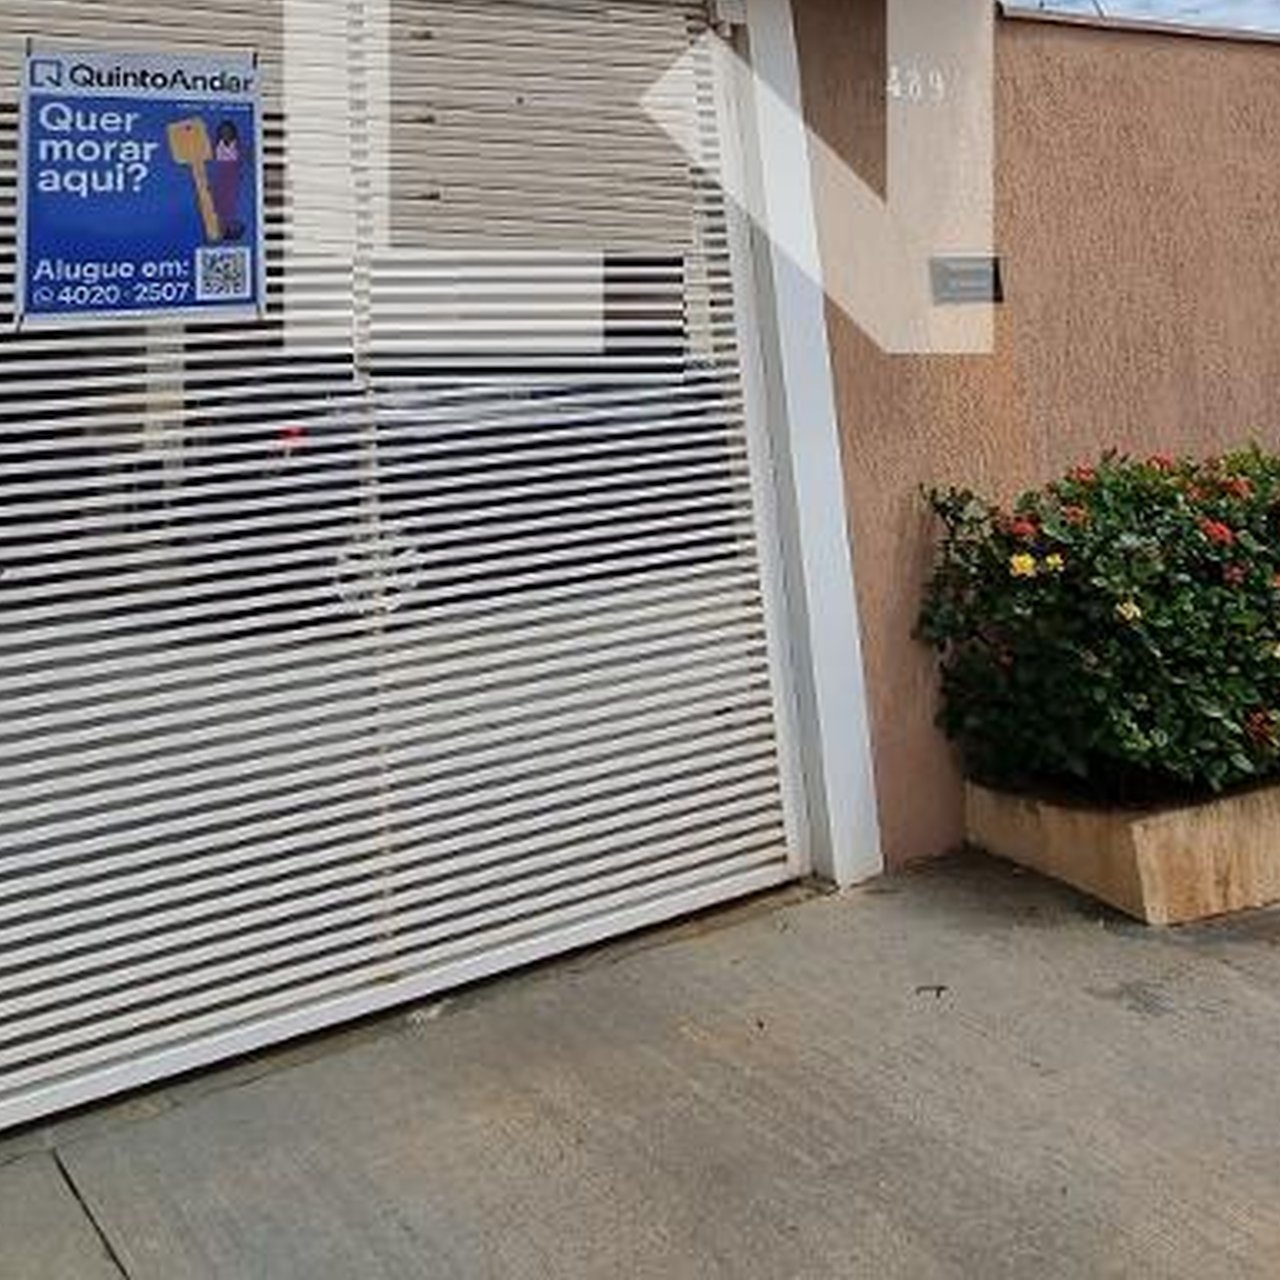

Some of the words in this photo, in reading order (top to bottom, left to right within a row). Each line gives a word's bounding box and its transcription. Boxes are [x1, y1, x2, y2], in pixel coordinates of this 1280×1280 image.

[70, 64, 254, 93] QuintoAndar
[39, 102, 139, 132] Quer
[38, 137, 159, 162] morar
[37, 163, 149, 197] aqui?
[32, 259, 135, 285] Alugue
